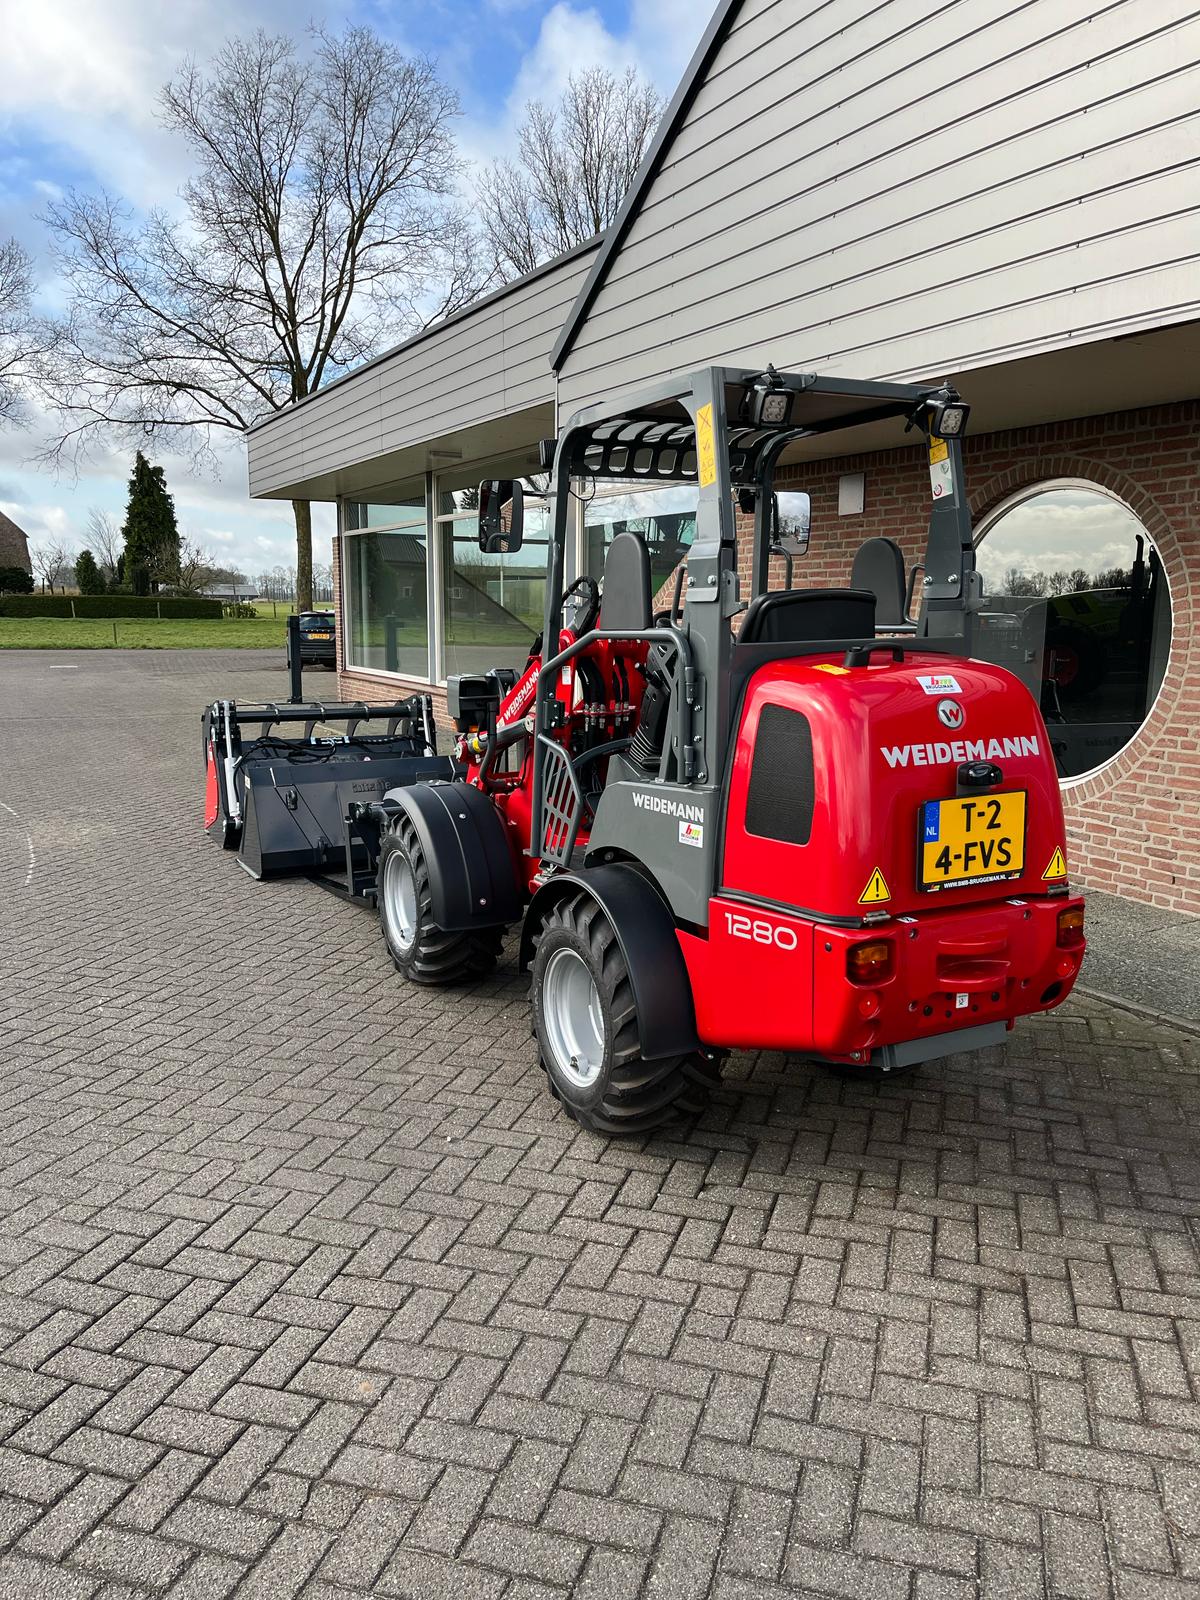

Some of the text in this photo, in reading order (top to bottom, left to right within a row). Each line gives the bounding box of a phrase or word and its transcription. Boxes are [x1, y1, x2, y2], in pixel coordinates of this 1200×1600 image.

[503, 667, 540, 721] WEIDEMANN
[880, 735, 1040, 768] WEIDEMANN
[632, 792, 704, 823] WEIDEMANN
[961, 800, 1002, 832] T-2
[926, 826, 937, 837] NL
[935, 837, 1012, 875] 4-FVS
[724, 912, 798, 950] 1280
